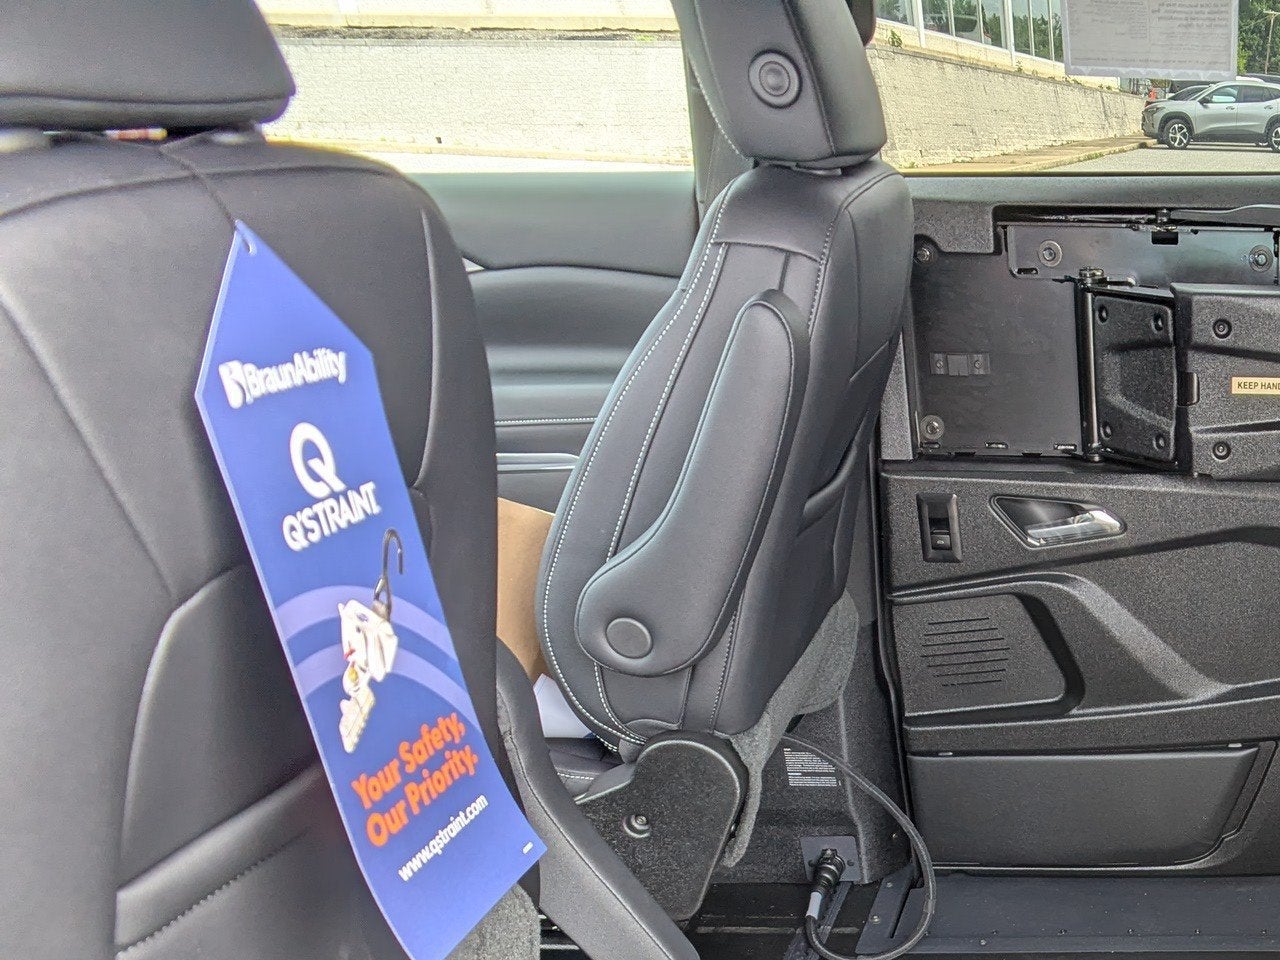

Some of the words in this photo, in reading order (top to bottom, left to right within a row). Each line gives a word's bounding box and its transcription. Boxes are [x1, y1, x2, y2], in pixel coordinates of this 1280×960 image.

[243, 347, 347, 399] BraunAbility
[1237, 381, 1259, 390] KEEP
[351, 758, 402, 809] Your
[366, 800, 409, 847] Our
[404, 744, 479, 815] Priority.
[398, 794, 489, 881] www.qstraint.com
